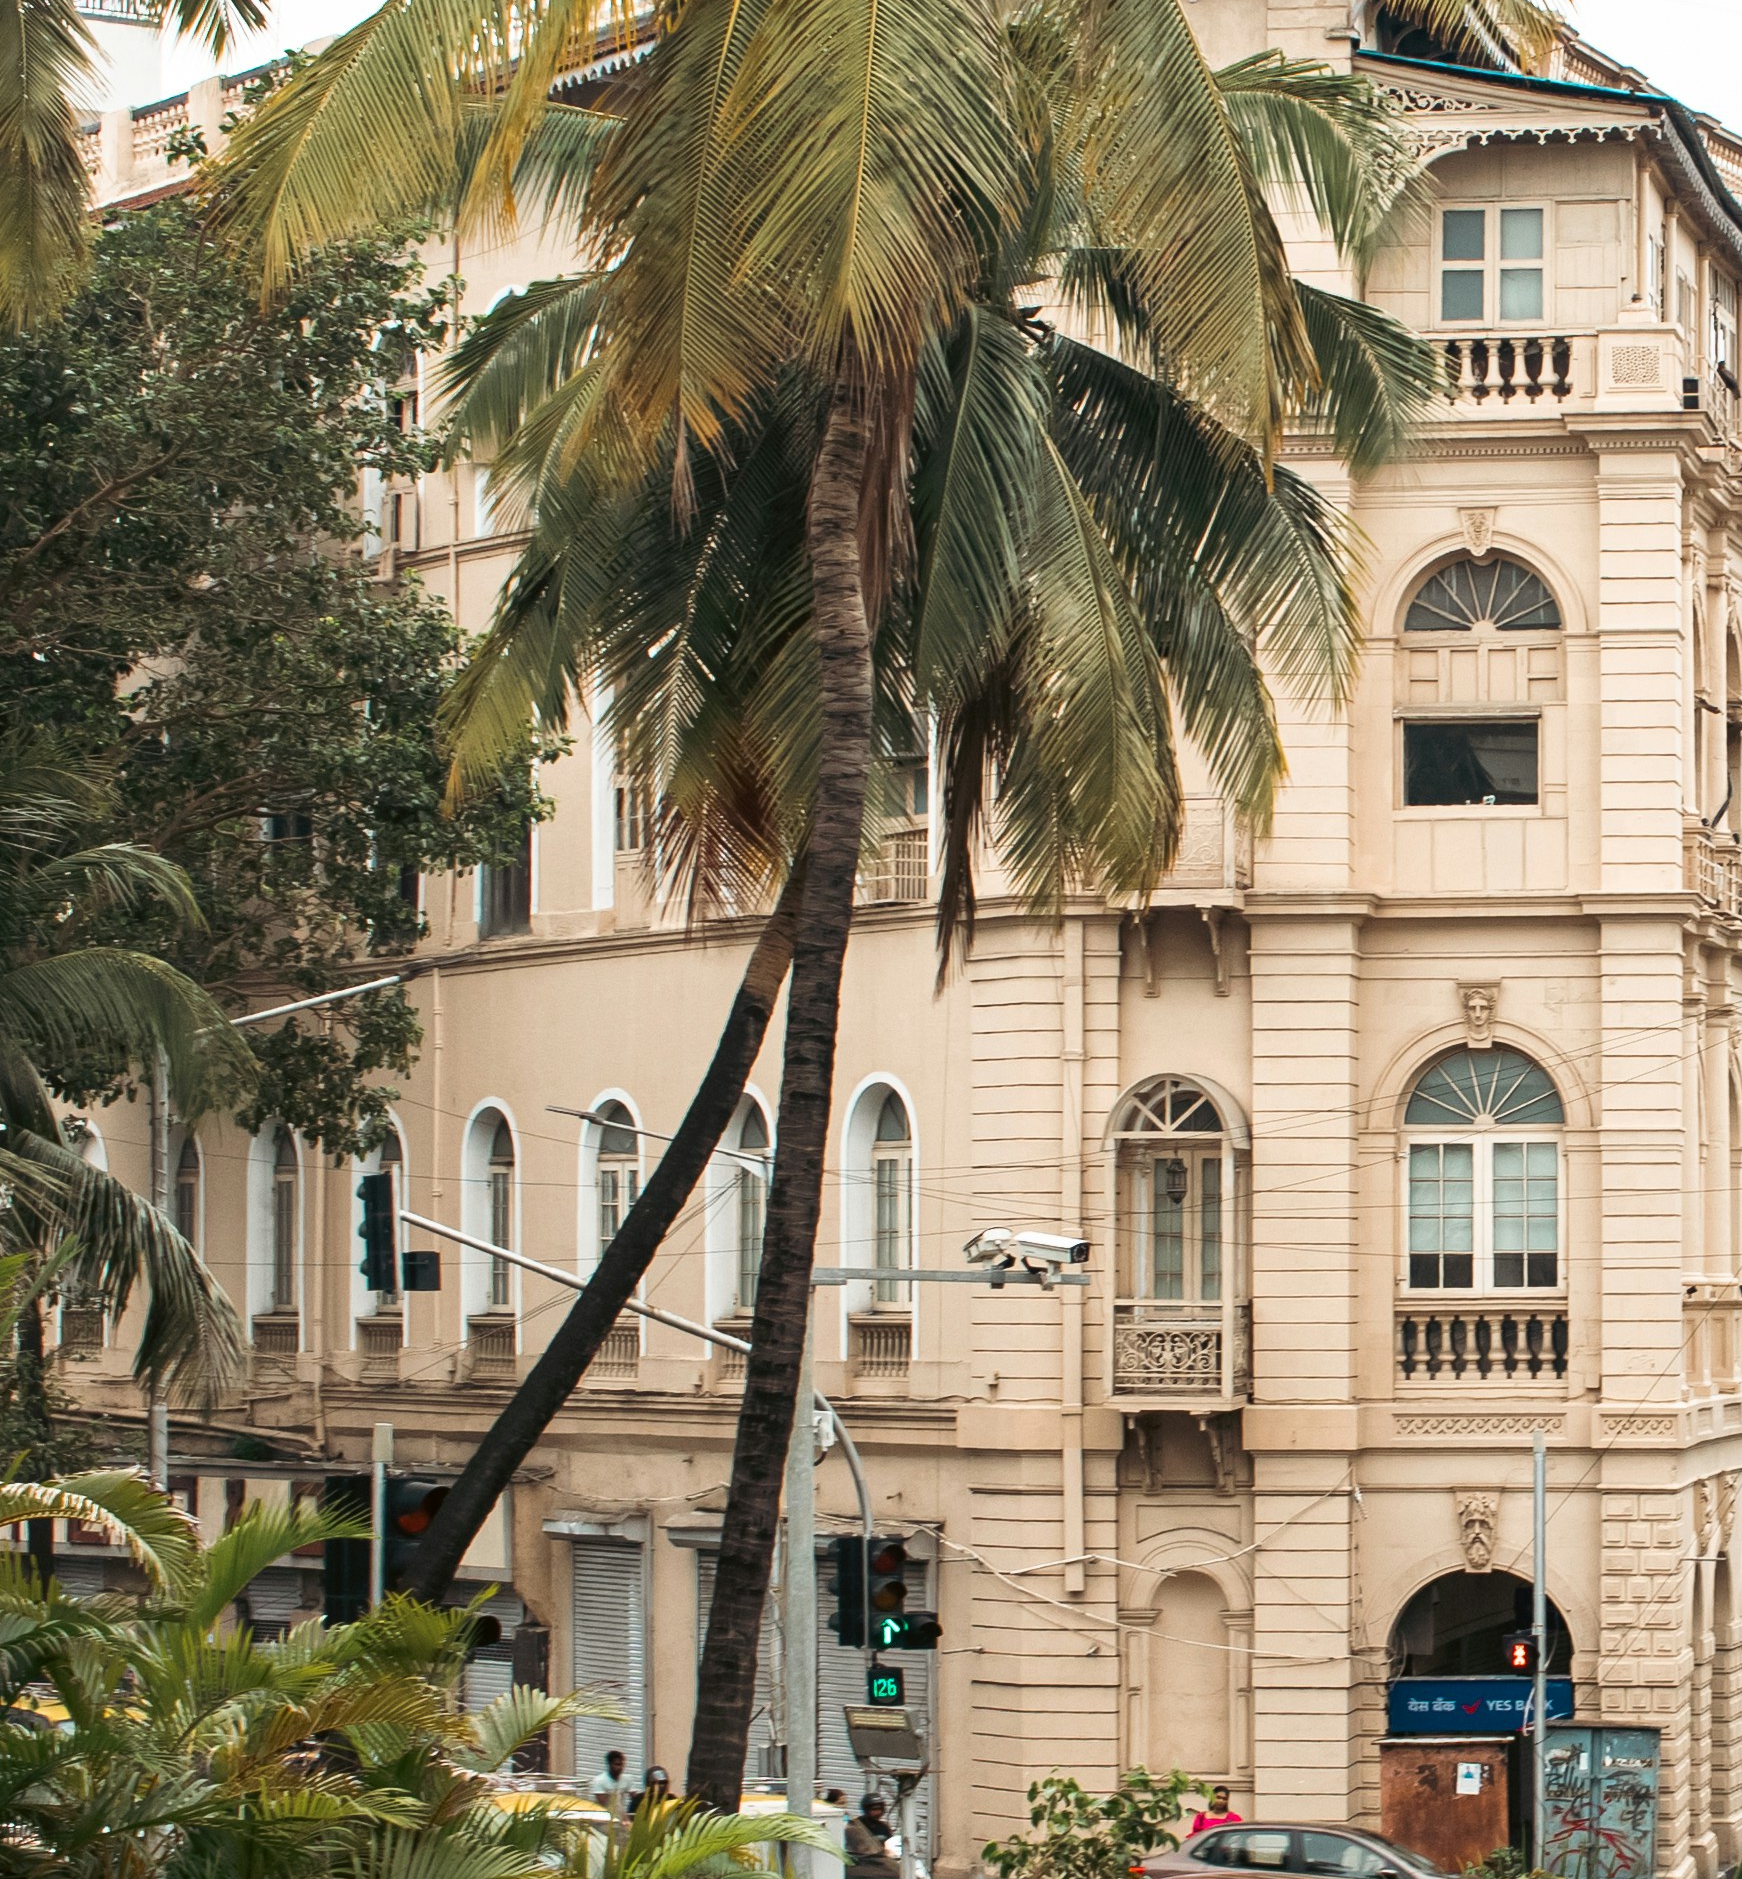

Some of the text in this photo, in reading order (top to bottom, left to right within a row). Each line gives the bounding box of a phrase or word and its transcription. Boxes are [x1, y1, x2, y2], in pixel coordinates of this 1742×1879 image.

[873, 1677, 897, 1698] 126
[1486, 1700, 1554, 1711] YES BAK
